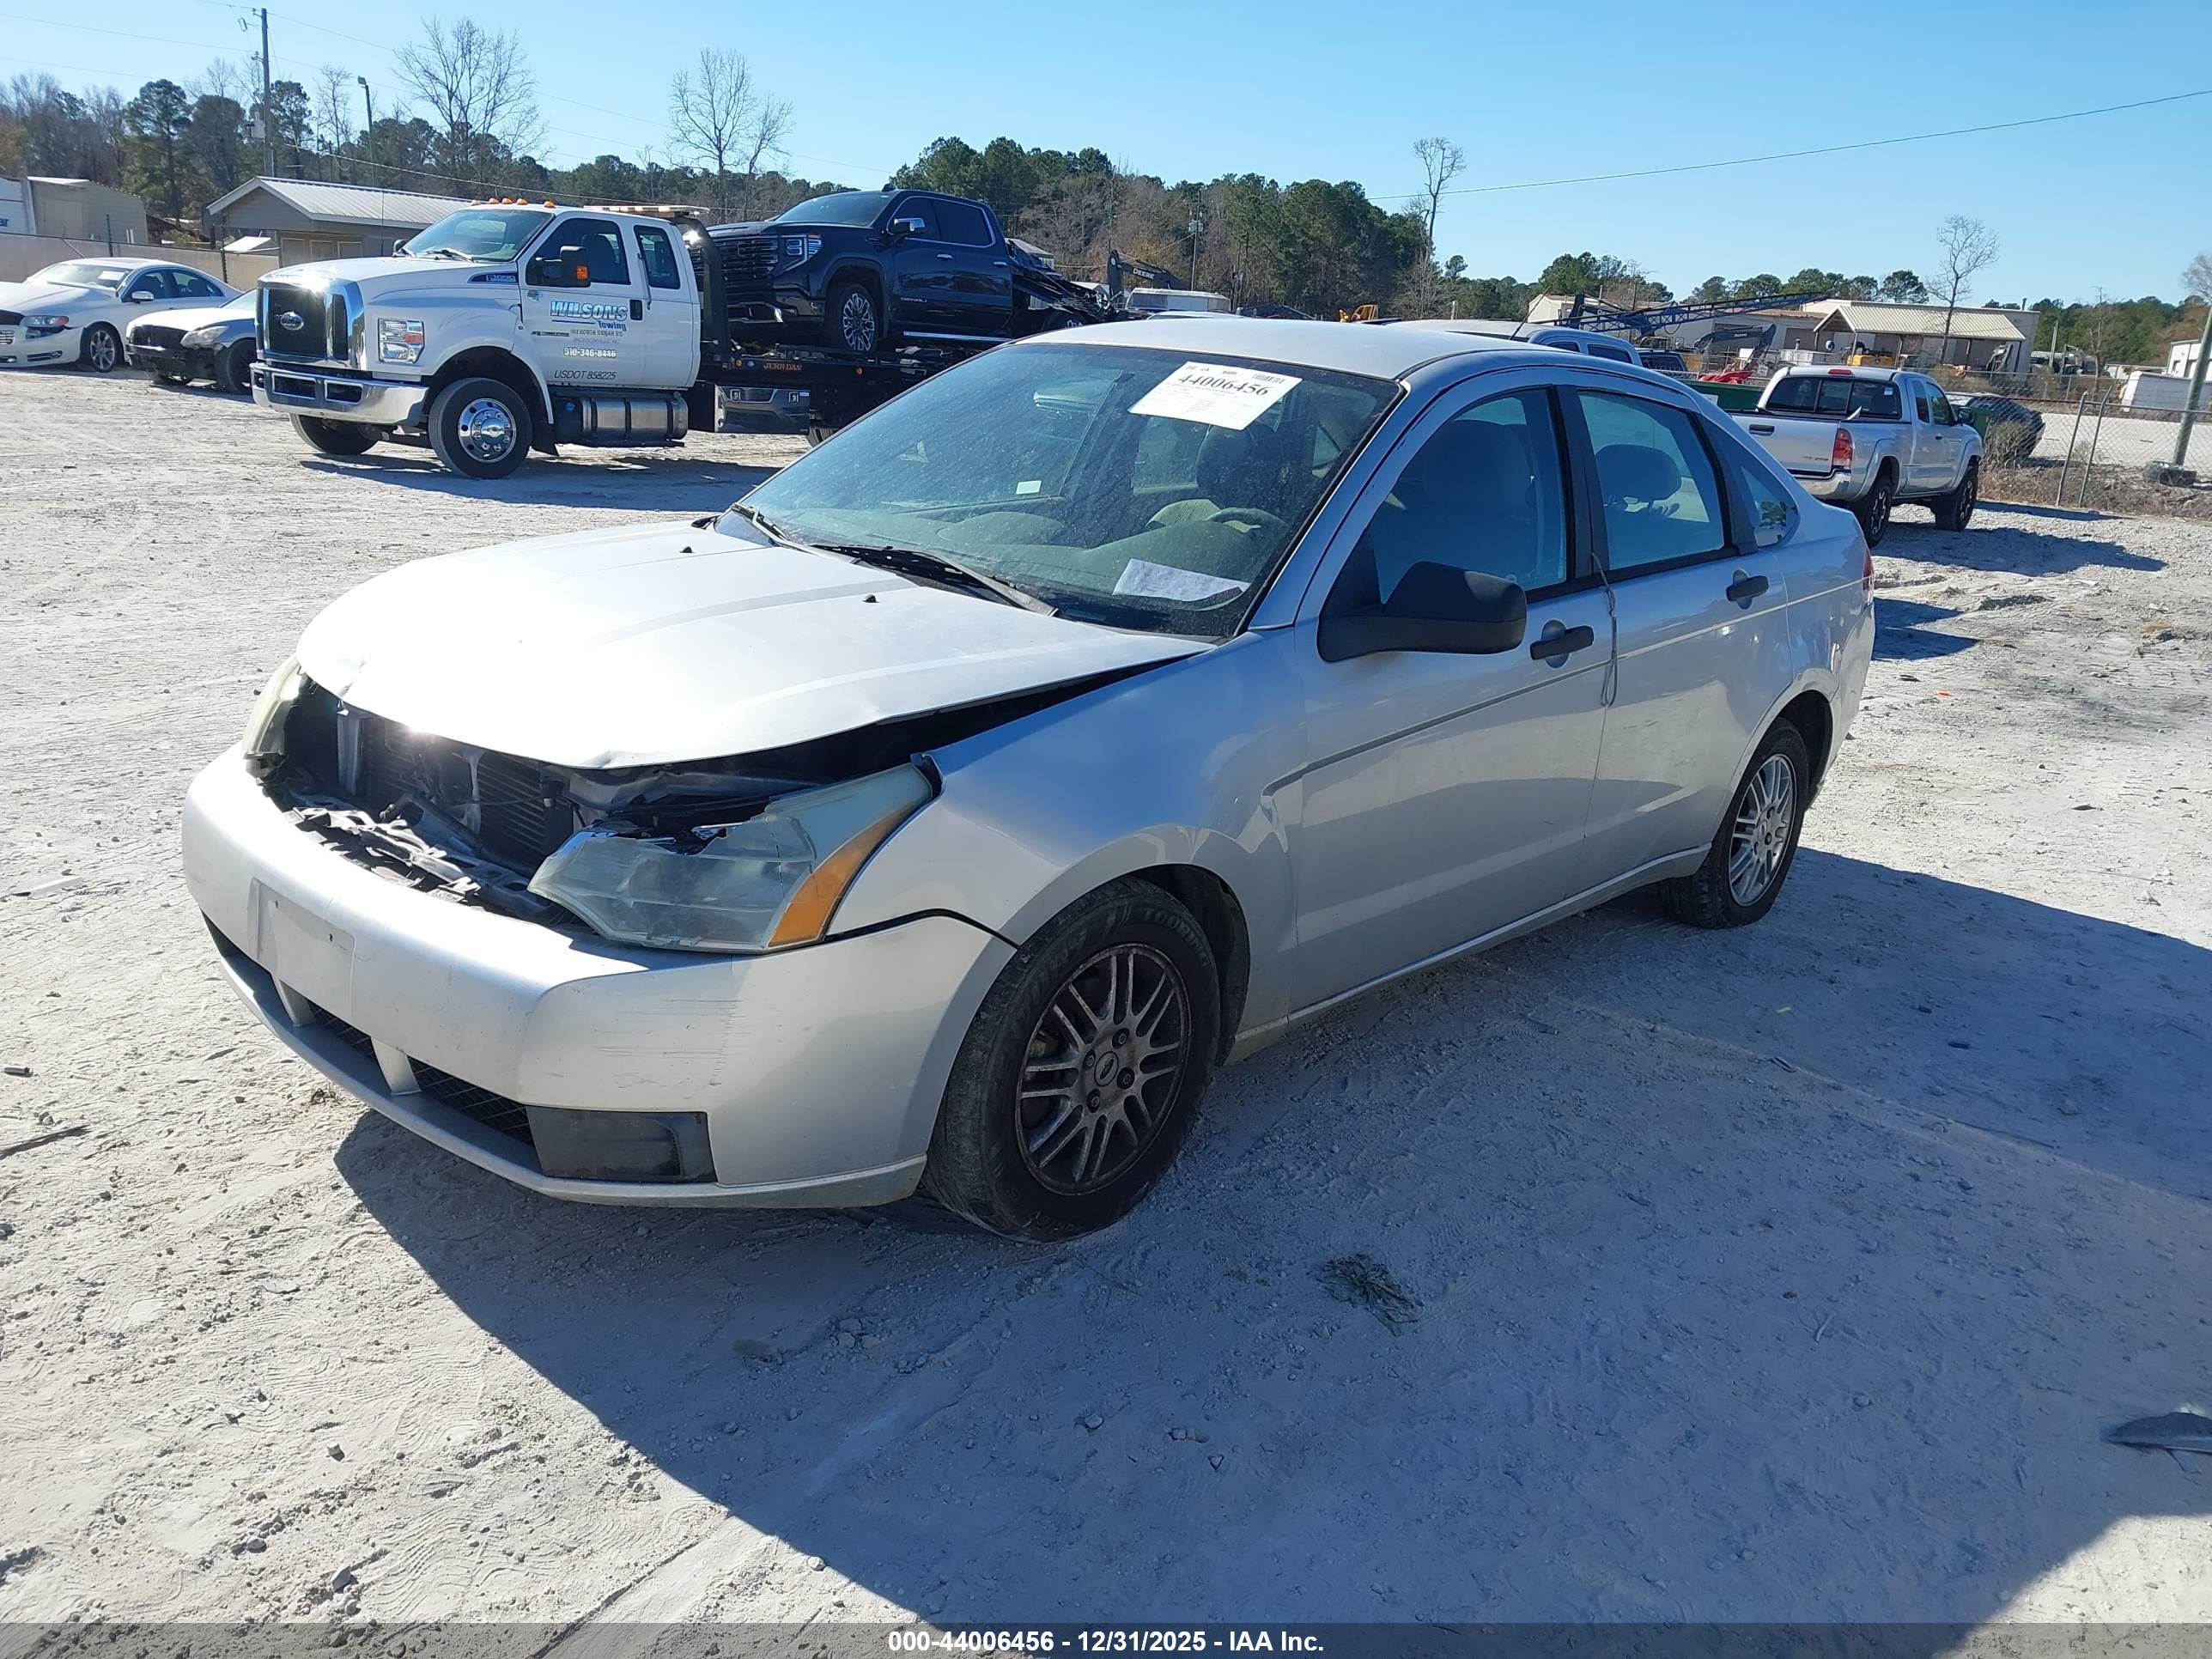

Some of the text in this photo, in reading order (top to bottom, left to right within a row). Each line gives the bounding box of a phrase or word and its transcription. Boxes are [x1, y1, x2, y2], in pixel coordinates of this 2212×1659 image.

[1133, 267, 1155, 280] DEERE
[550, 301, 629, 322] WILSONS
[598, 320, 628, 332] Towing
[554, 369, 617, 380] USDOT 858225
[1177, 374, 1273, 397] 44006456
